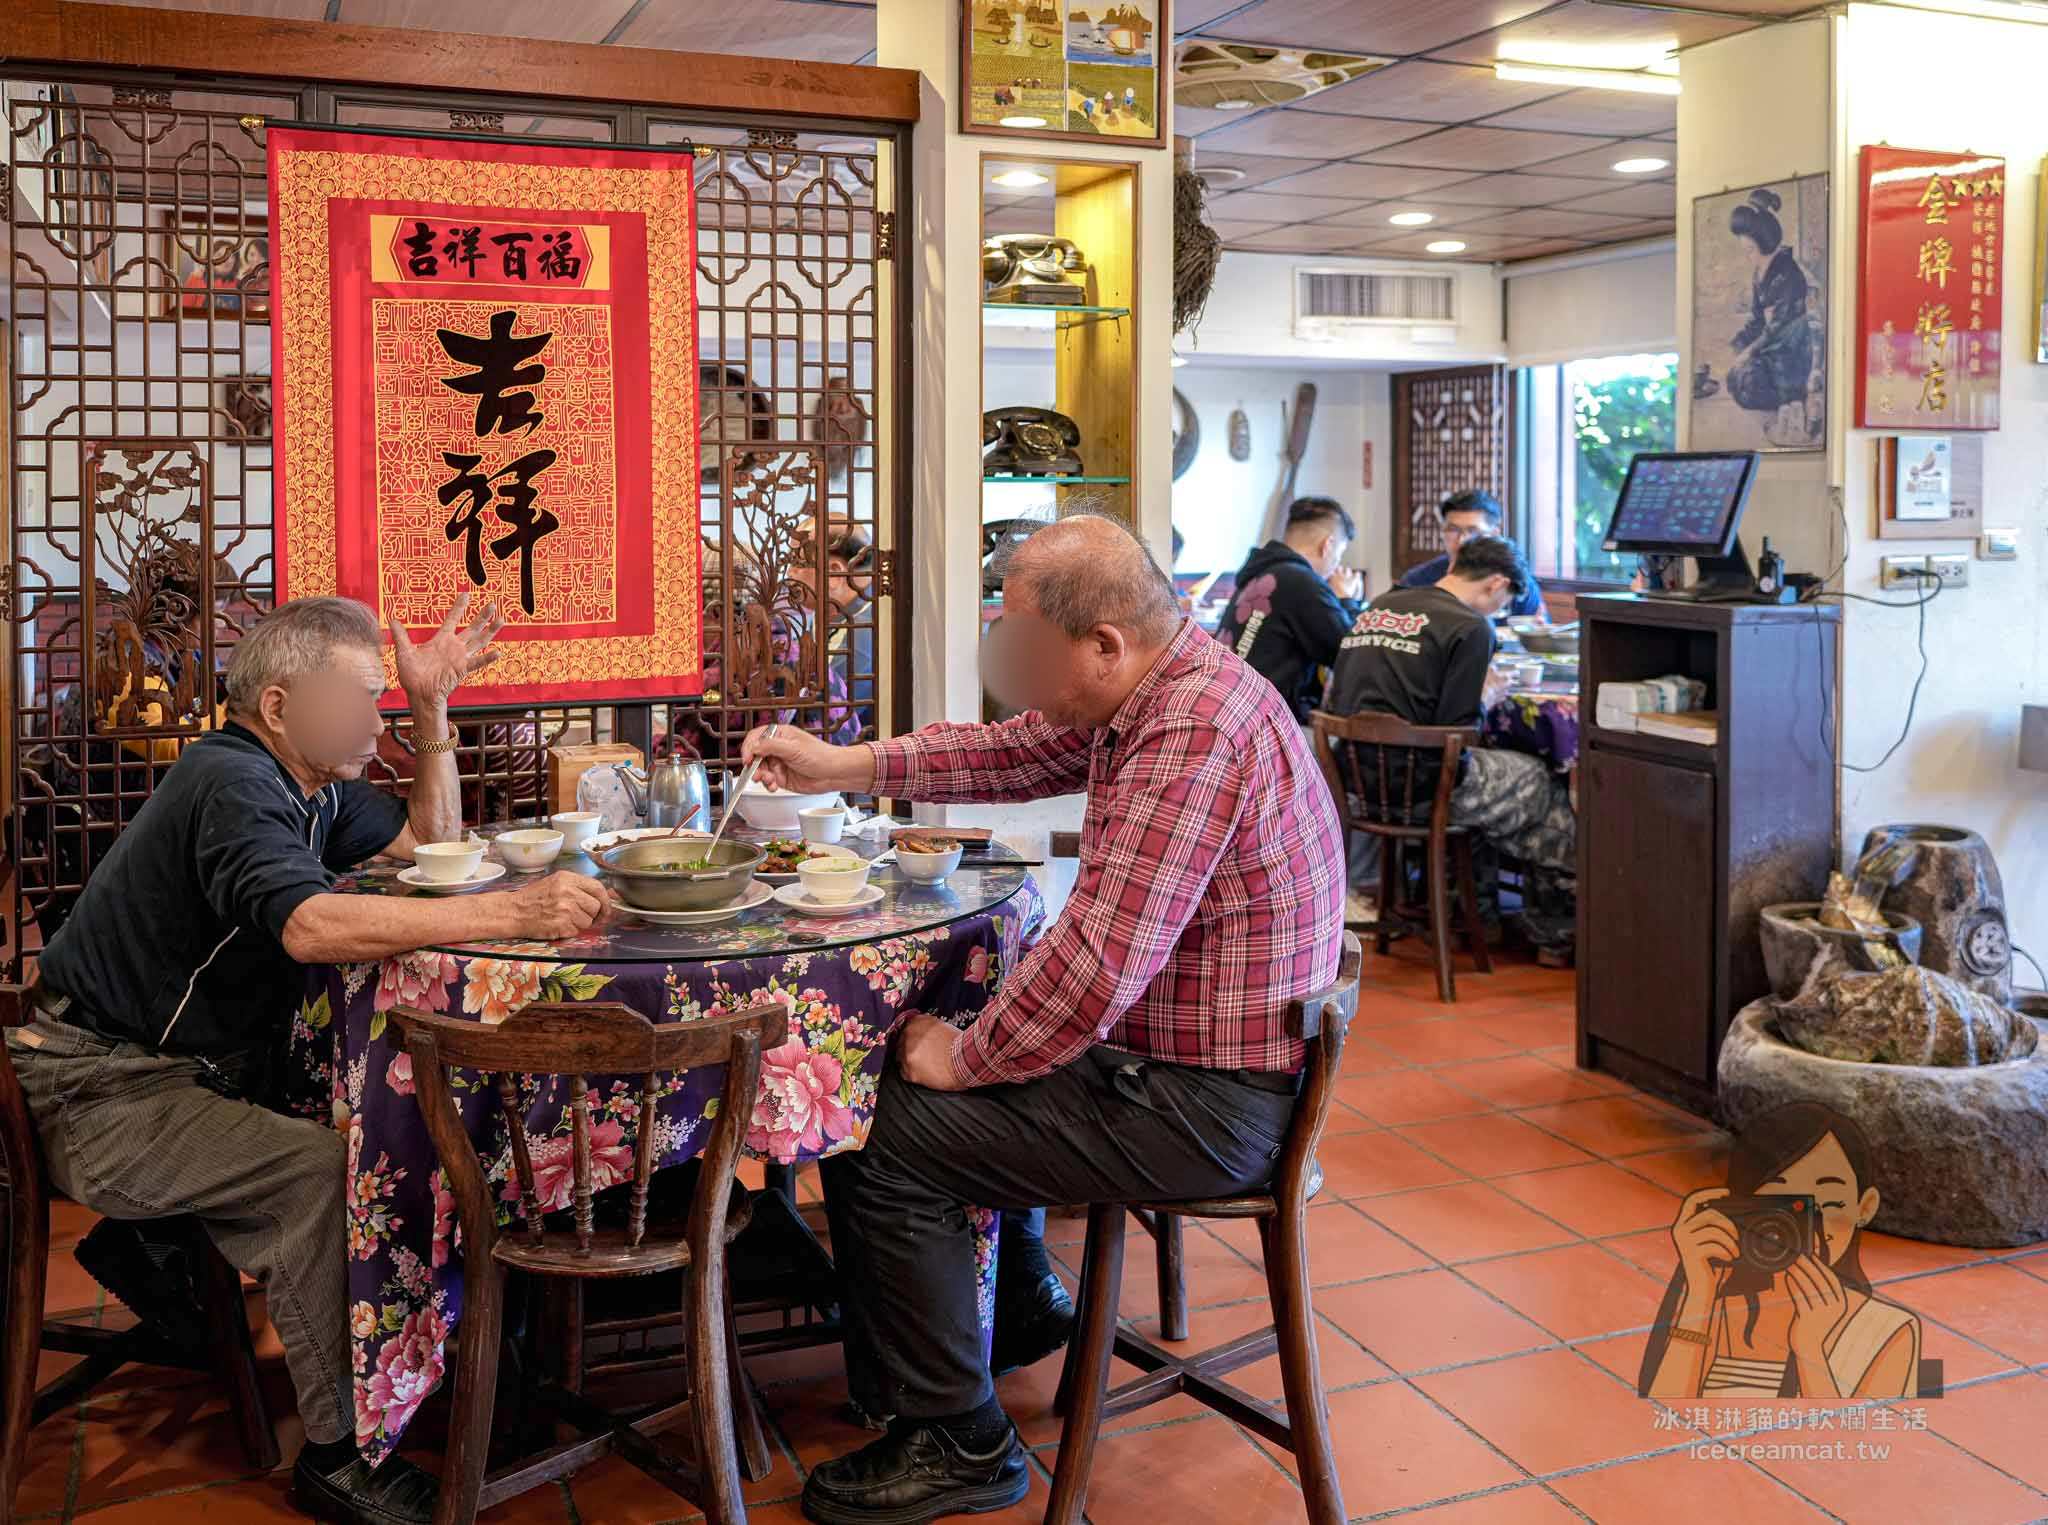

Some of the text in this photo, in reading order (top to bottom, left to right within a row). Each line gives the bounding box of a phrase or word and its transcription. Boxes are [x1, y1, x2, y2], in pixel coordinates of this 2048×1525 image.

[403, 222, 581, 281] 吉祥百福
[436, 310, 560, 616] 吉祥
[1340, 636, 1421, 655] SERVICE
